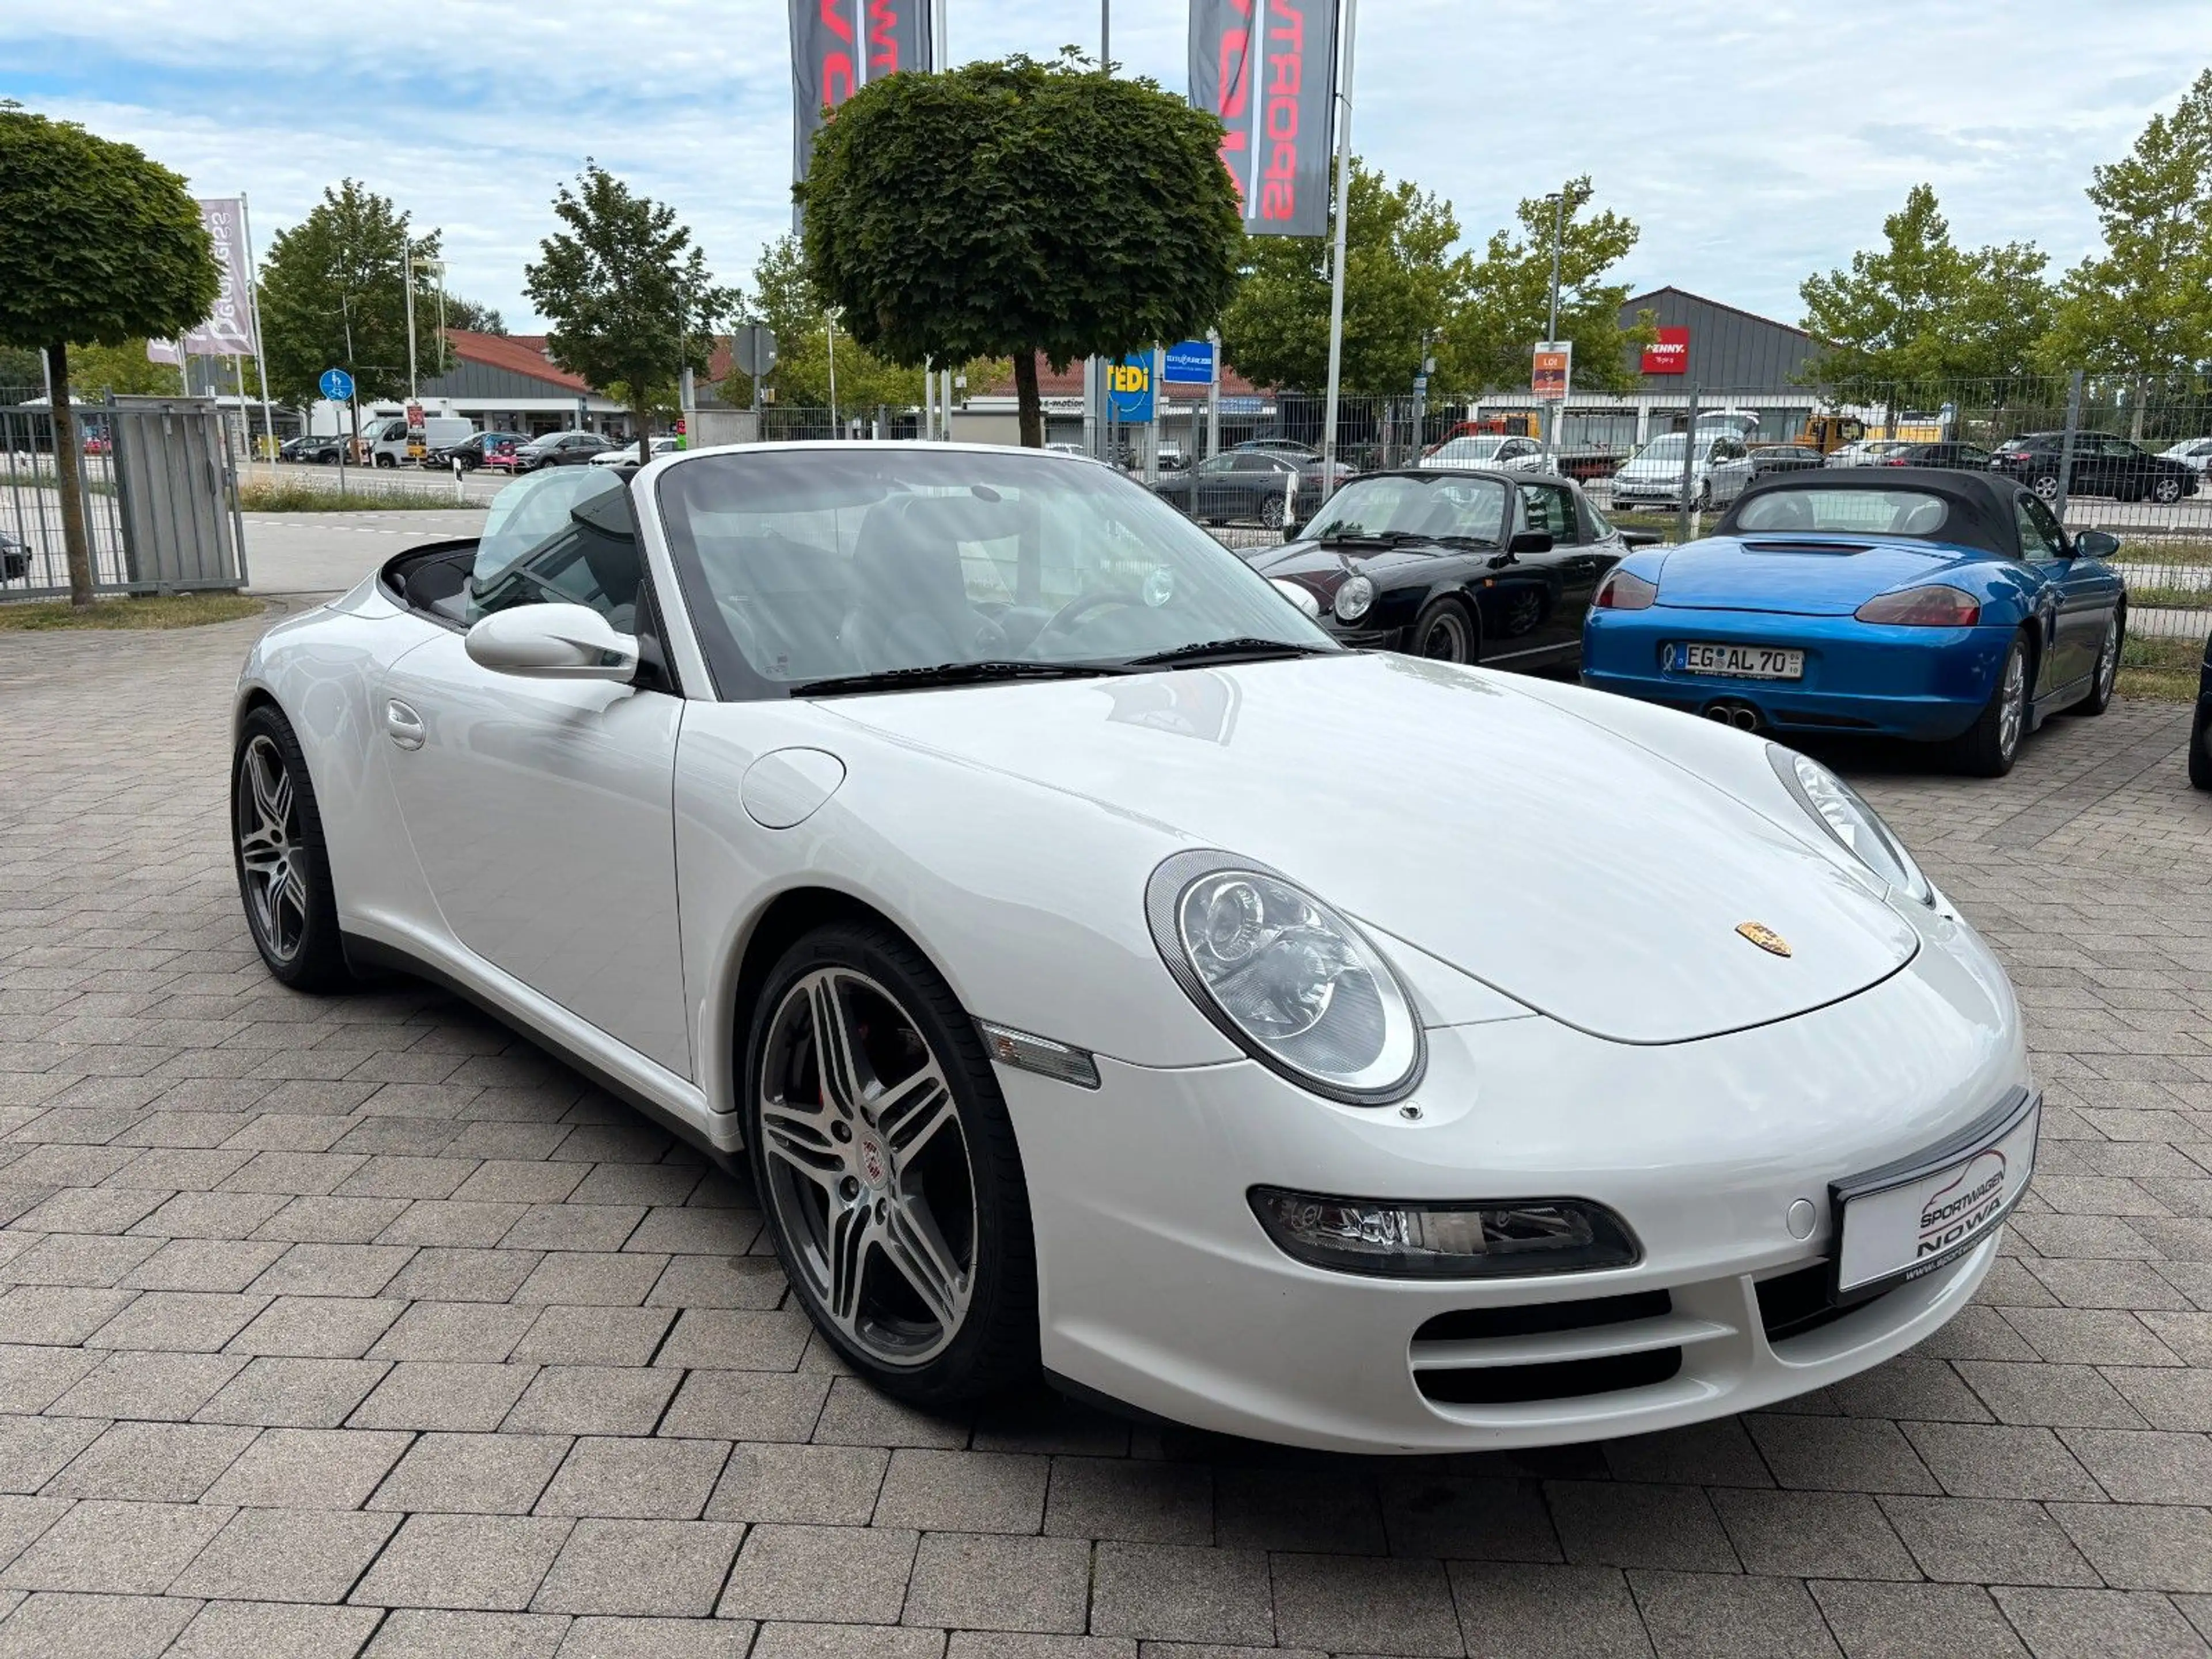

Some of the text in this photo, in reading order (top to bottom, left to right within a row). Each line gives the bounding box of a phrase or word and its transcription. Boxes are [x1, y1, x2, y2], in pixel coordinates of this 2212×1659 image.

[1688, 646, 1713, 667] EG
[1728, 649, 1753, 670] AL
[1760, 651, 1786, 672] 70
[1916, 1197, 2001, 1257] NOWA
[1921, 1170, 2005, 1228] SPORTWAGEN
